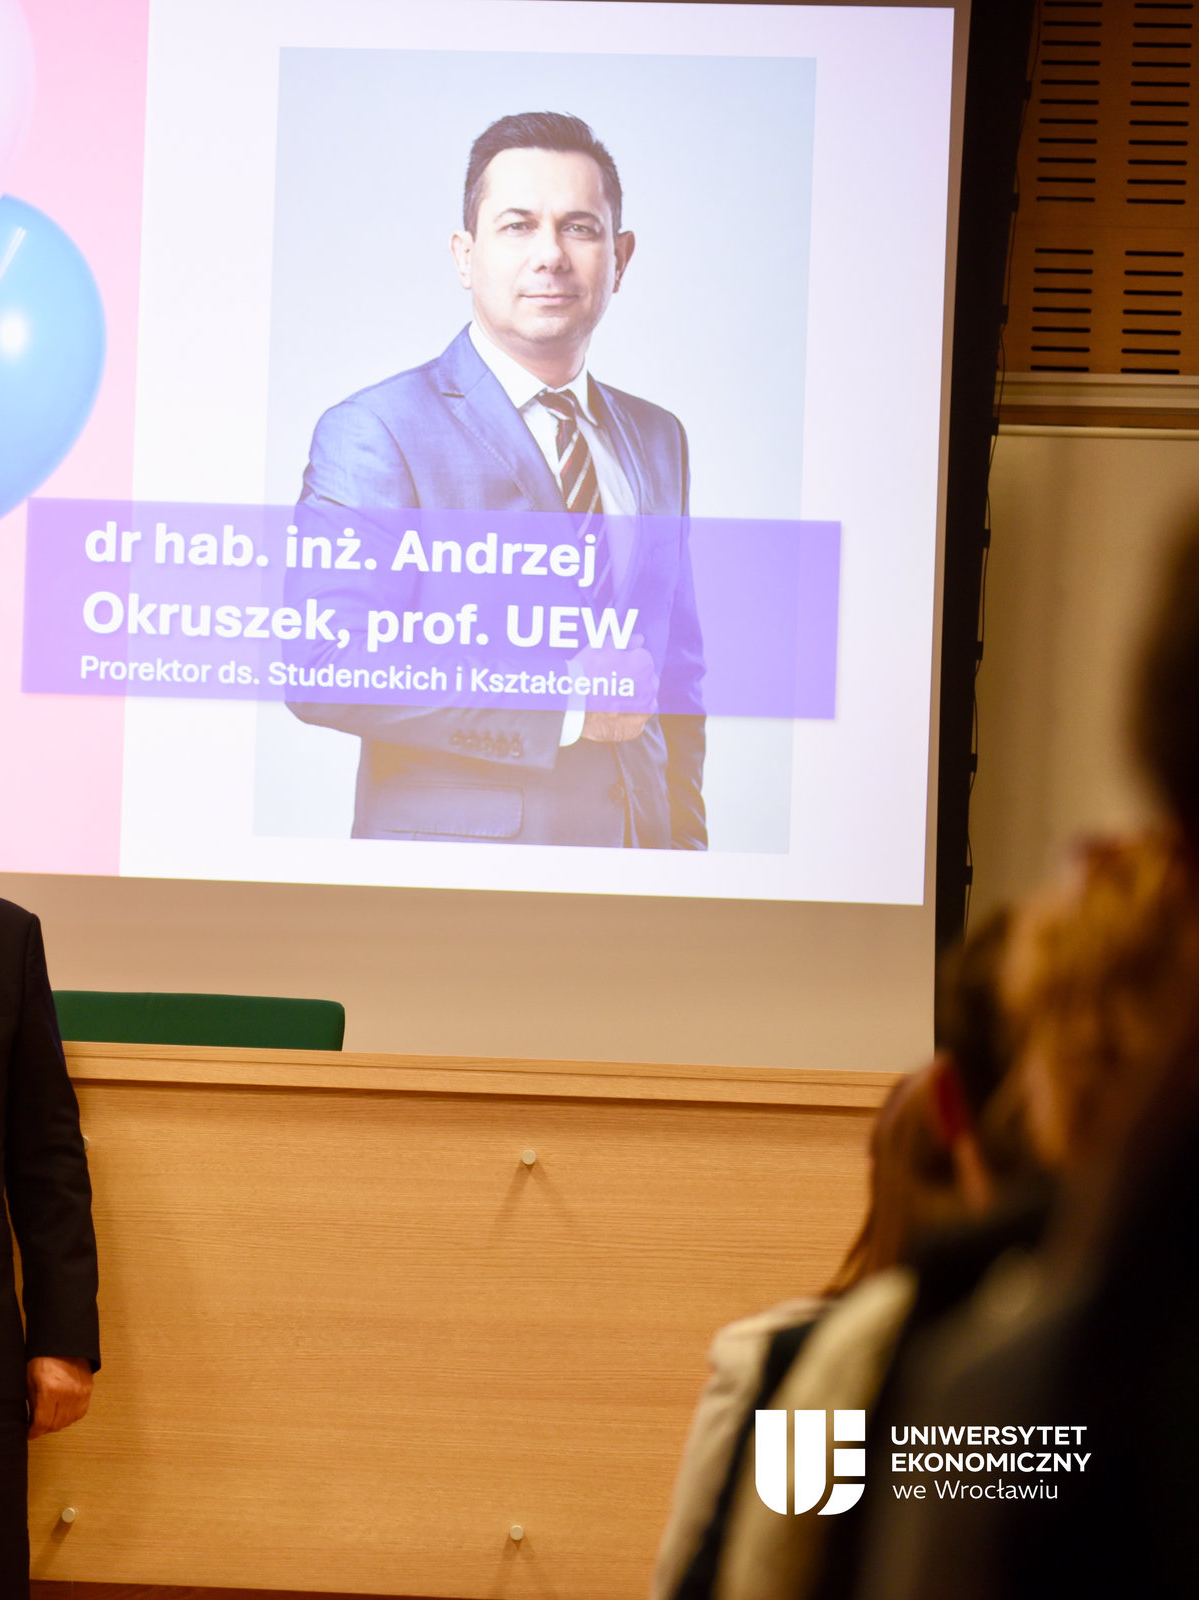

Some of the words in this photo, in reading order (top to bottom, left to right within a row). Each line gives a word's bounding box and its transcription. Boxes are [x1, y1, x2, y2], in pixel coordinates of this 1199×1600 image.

[85, 521, 140, 564] dr
[155, 524, 268, 568] hab.
[286, 525, 378, 571] inż.
[392, 530, 597, 586] Andrzej
[82, 591, 352, 646] Okruszek,
[367, 602, 489, 651] prof.
[505, 606, 638, 649] UEW
[81, 655, 211, 683] Prorektor
[219, 658, 260, 686] ds.
[268, 661, 447, 692] Studenckich
[456, 666, 463, 691] i
[471, 667, 635, 697] Kształcenia
